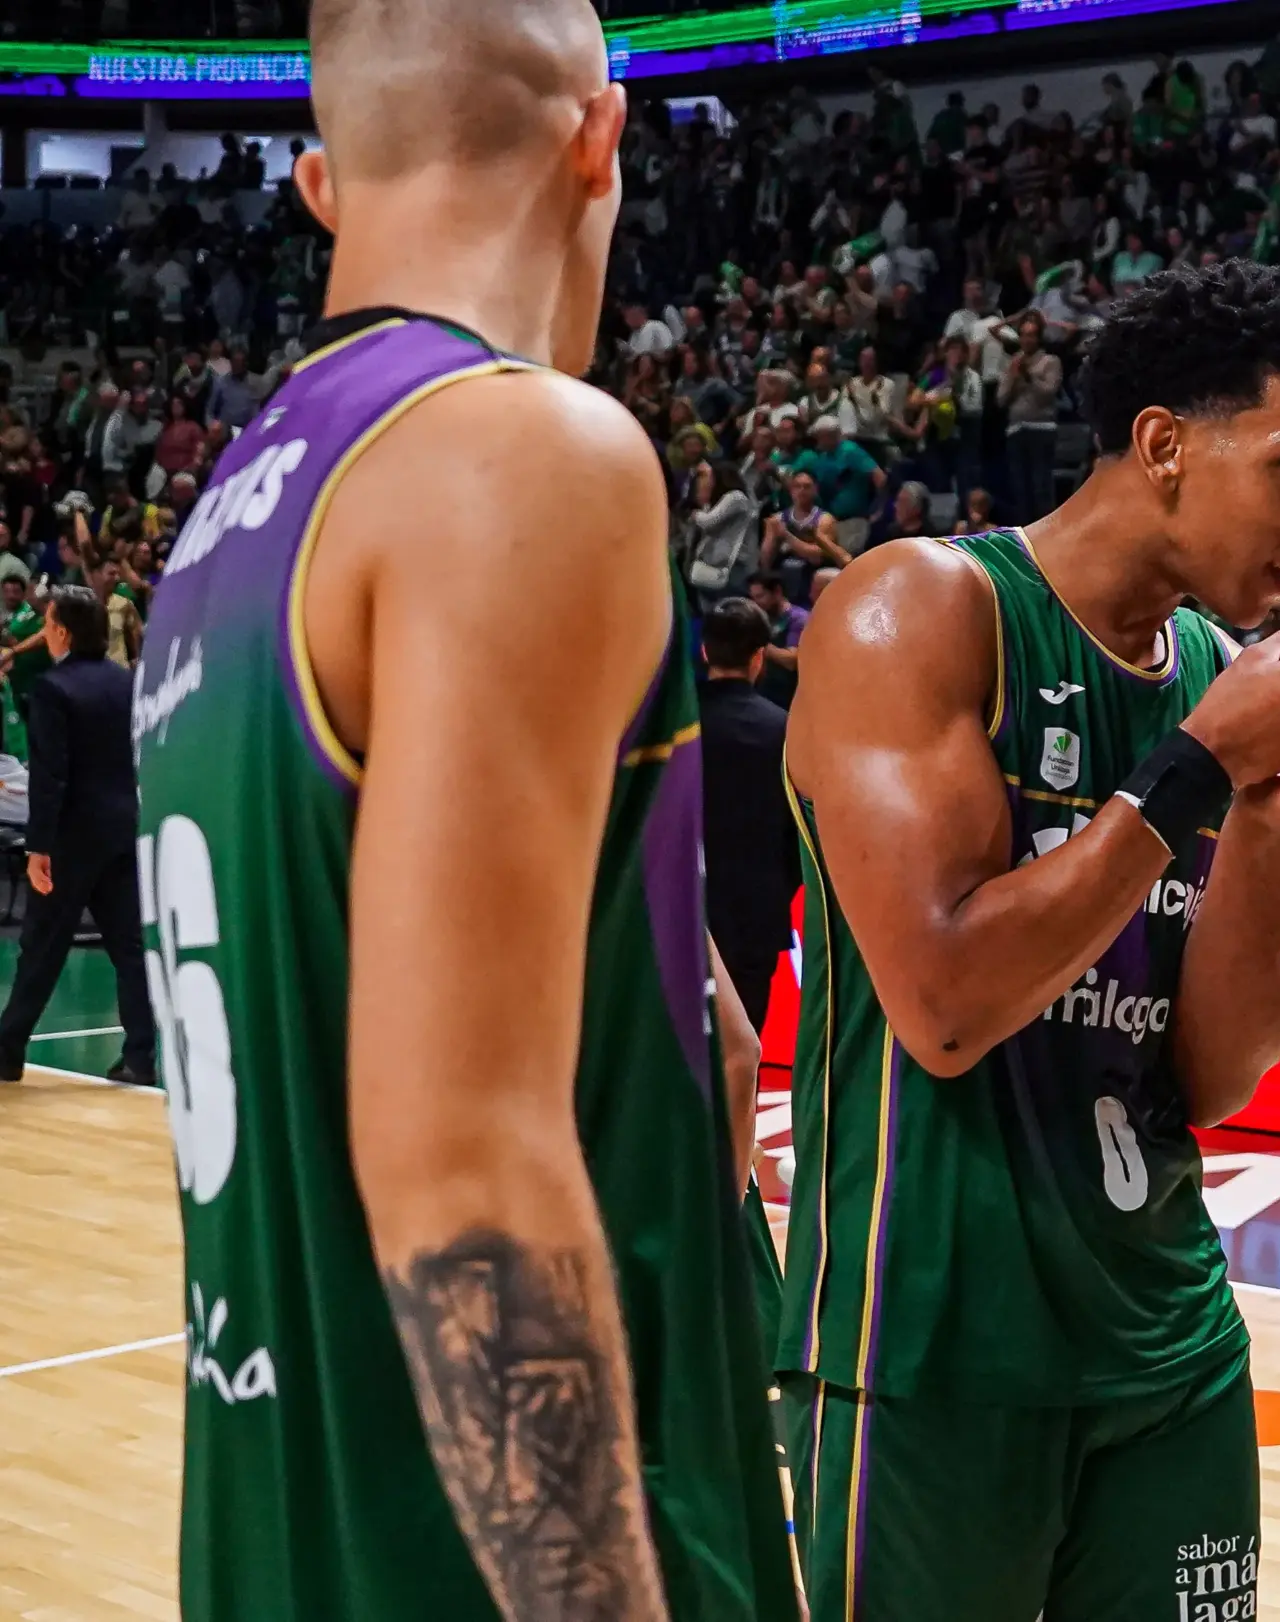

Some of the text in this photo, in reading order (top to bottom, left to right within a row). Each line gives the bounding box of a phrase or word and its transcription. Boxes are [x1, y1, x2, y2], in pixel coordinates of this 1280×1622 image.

[1094, 1096, 1148, 1212] 0
[1175, 1535, 1257, 1596] a má
[1176, 1533, 1241, 1561] sabor
